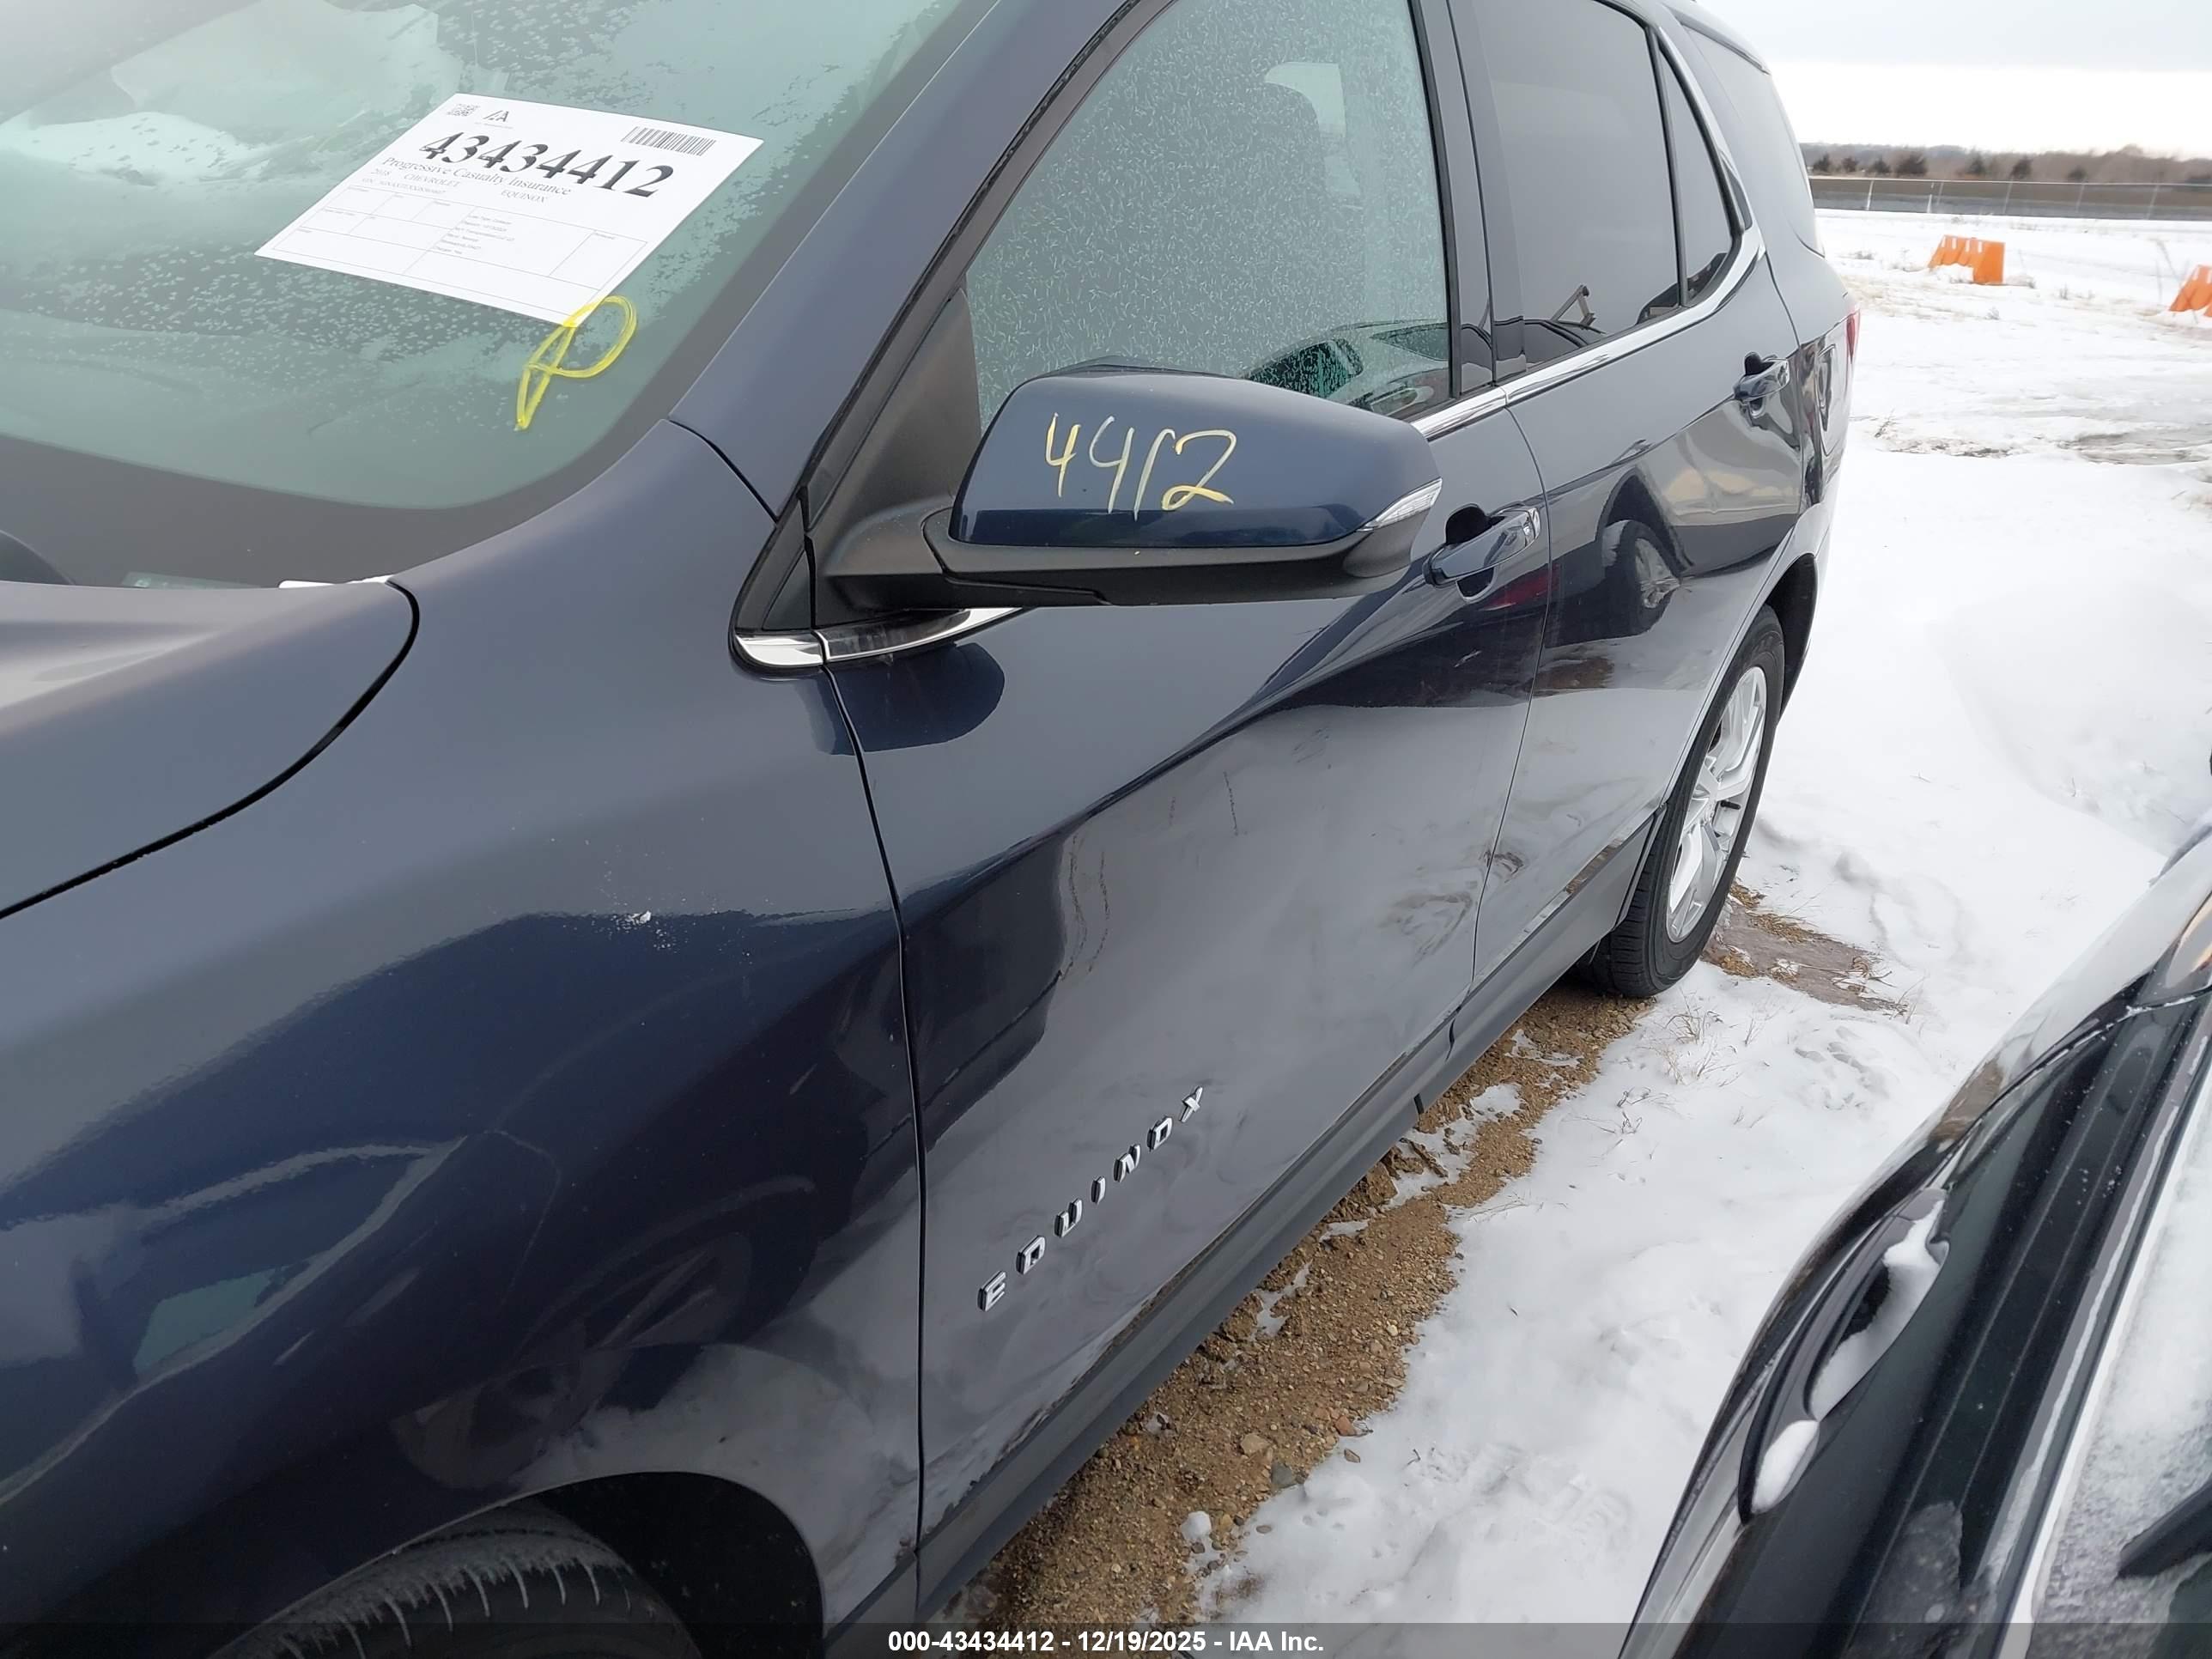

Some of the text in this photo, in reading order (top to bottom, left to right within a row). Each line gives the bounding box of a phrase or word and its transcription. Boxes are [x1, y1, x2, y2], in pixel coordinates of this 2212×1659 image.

[382, 157, 573, 196] Progressive Casualty Insurance
[403, 173, 462, 188] CHEVROLET
[501, 190, 550, 204] EQUINOX
[419, 131, 674, 198] 43434412
[1045, 412, 1237, 522] 4412
[977, 1085, 1203, 1311] EQUINOX
